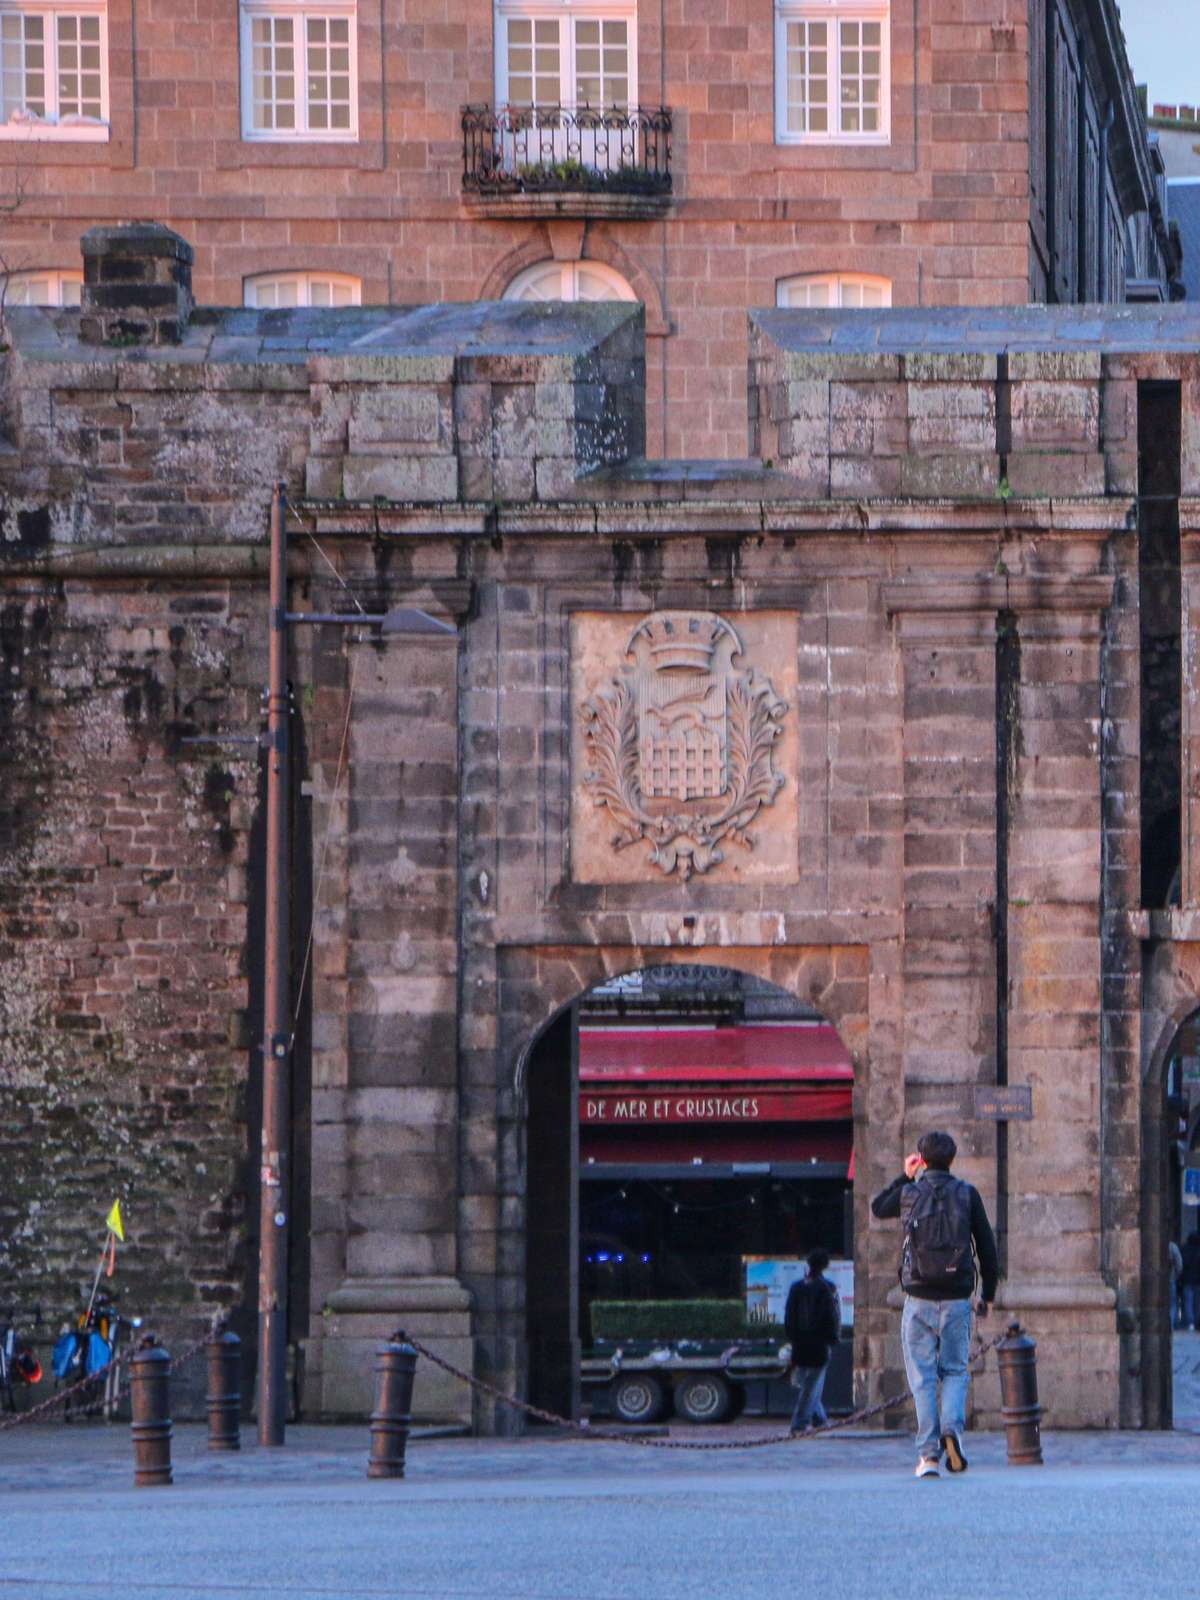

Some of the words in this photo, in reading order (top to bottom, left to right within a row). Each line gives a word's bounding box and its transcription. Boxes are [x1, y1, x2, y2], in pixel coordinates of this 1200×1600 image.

[587, 1101, 606, 1118] DE
[614, 1101, 648, 1118] MER
[654, 1100, 670, 1118] ET
[676, 1099, 758, 1117] CRUSTACES
